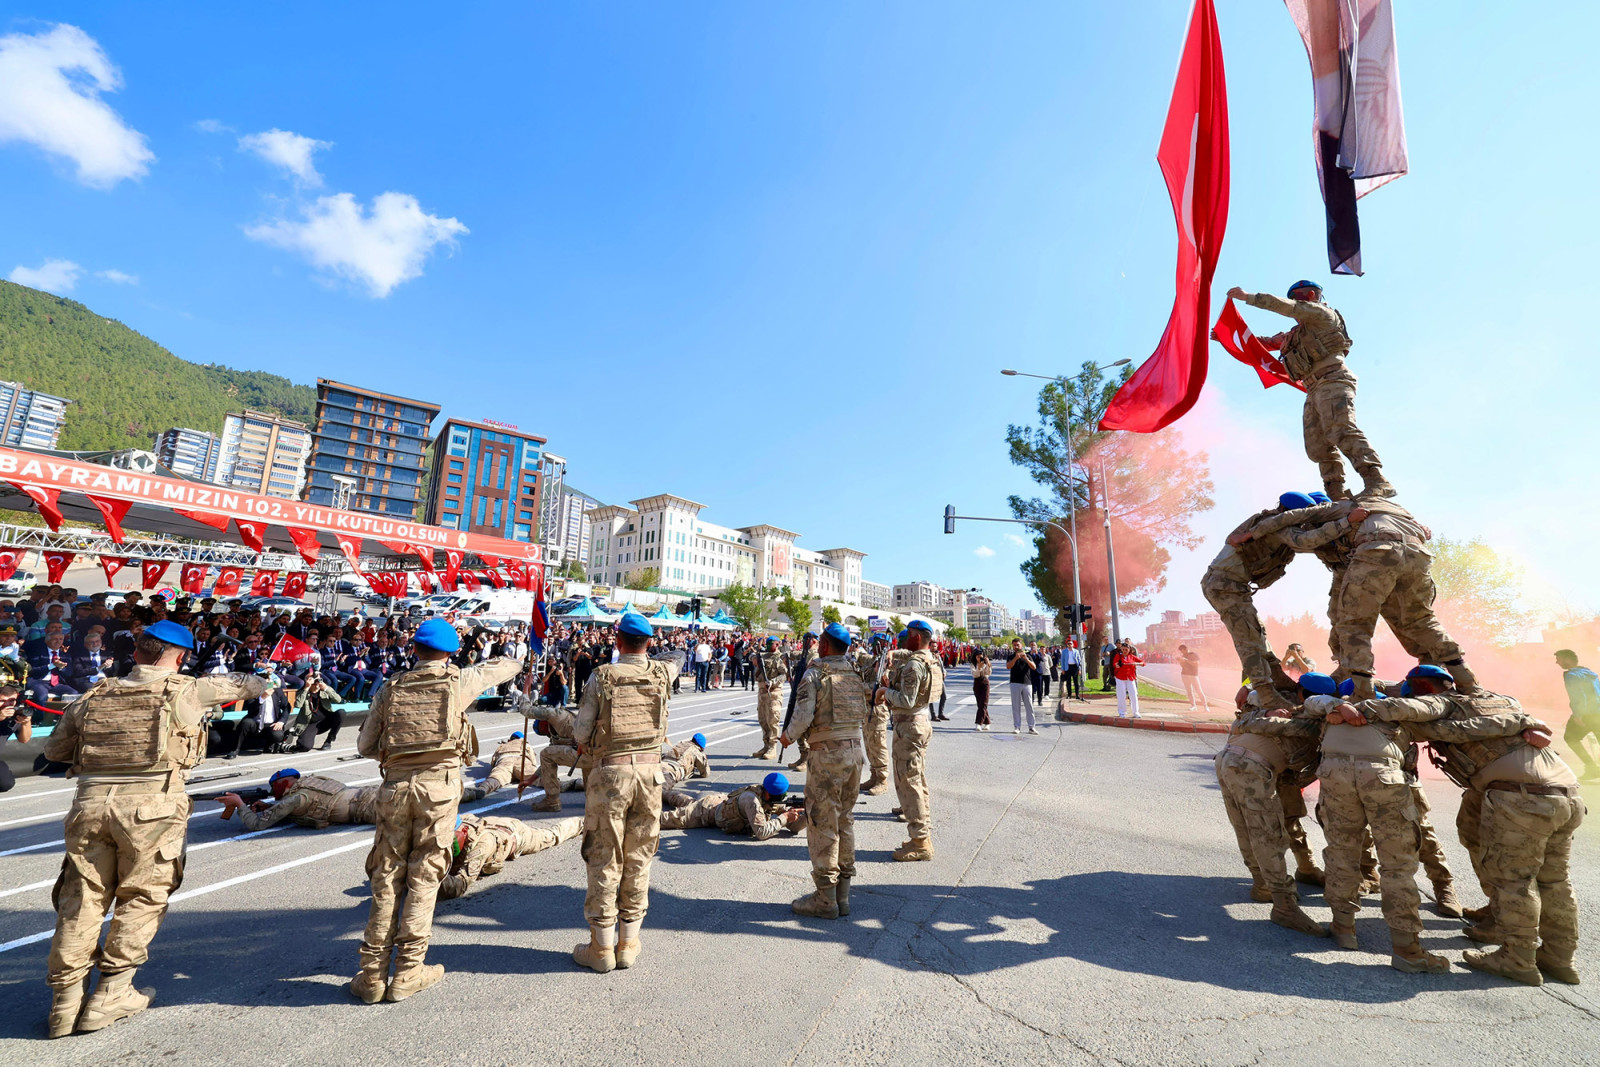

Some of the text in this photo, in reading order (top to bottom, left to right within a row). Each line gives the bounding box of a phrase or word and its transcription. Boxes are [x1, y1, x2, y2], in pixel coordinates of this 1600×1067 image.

[245, 498, 290, 519] 102.
[295, 506, 333, 525] YILI
[336, 514, 393, 535] KUTLU
[396, 524, 448, 544] OLSUN
